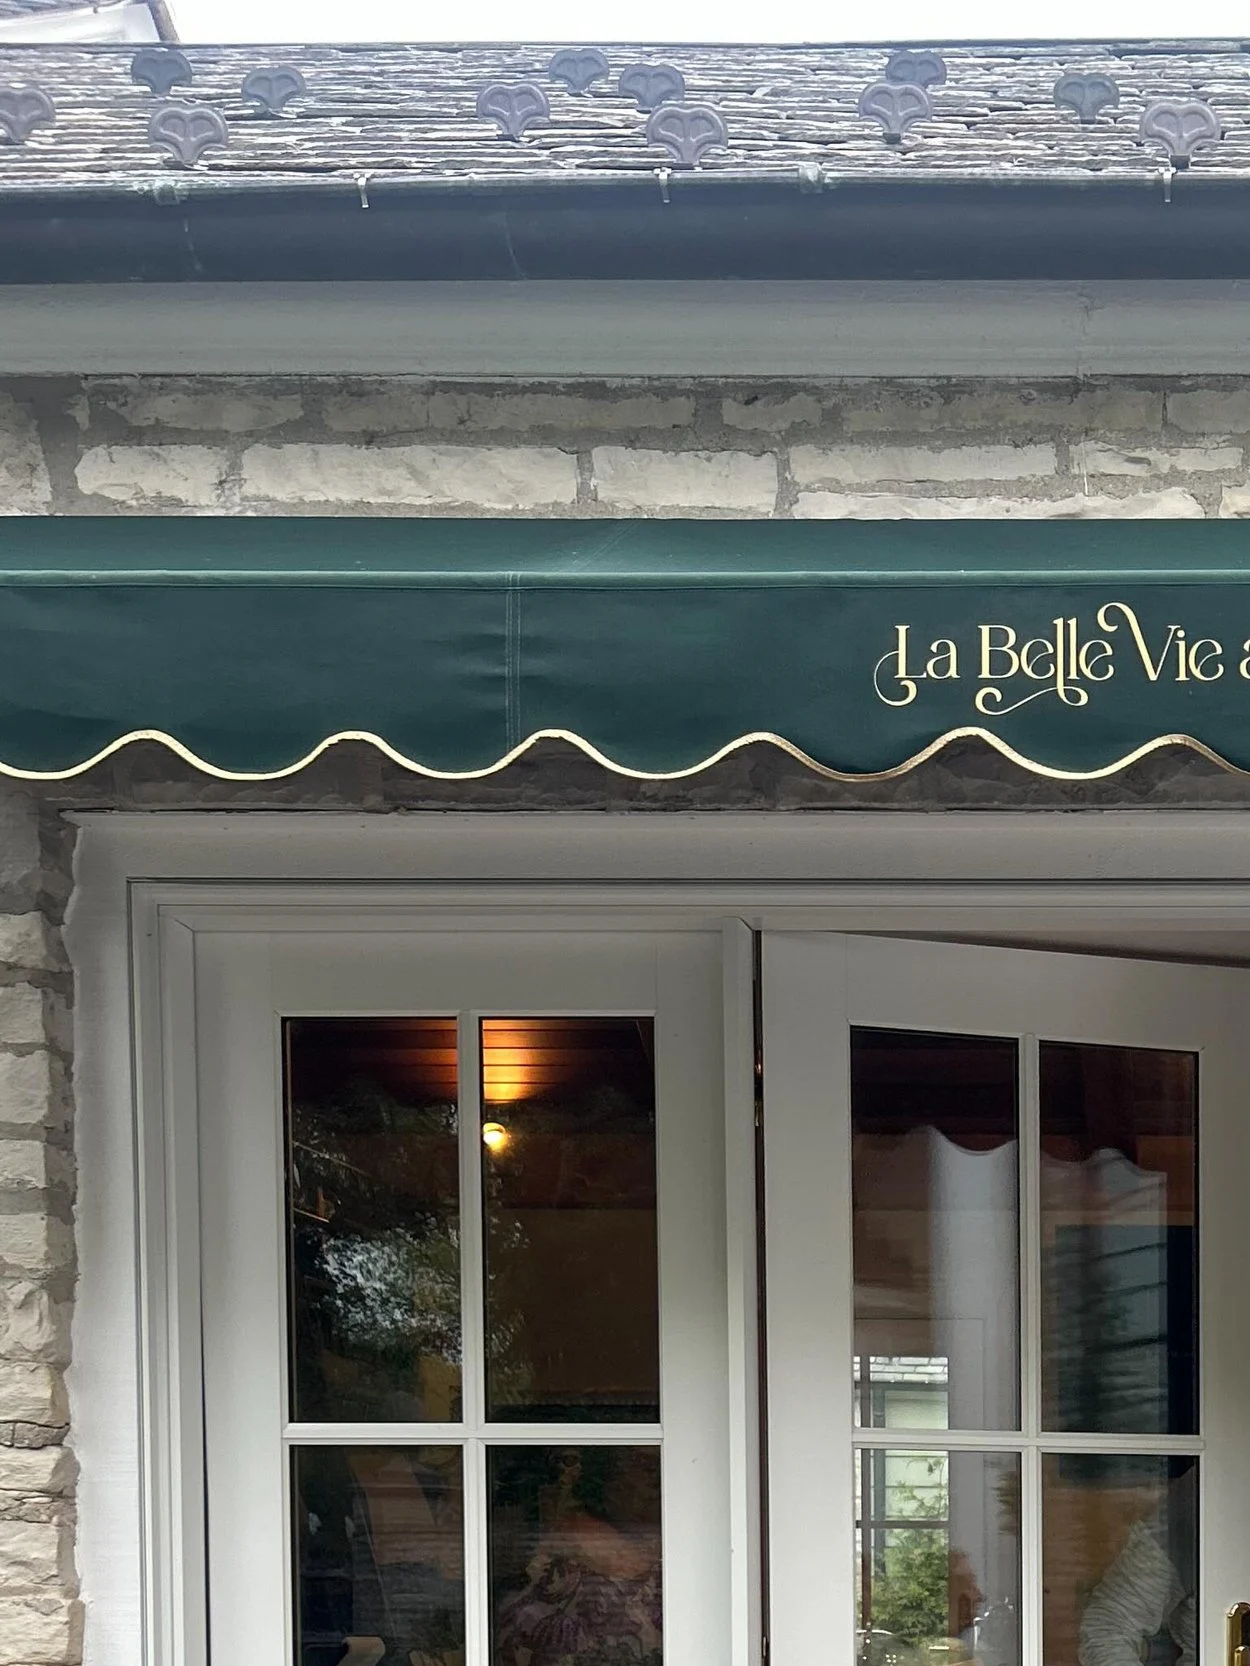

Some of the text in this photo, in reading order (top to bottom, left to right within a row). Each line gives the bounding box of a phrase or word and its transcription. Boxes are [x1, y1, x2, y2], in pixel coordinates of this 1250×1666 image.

[873, 623, 961, 707] La
[974, 616, 1116, 716] Belle
[1096, 601, 1225, 682] Vie
